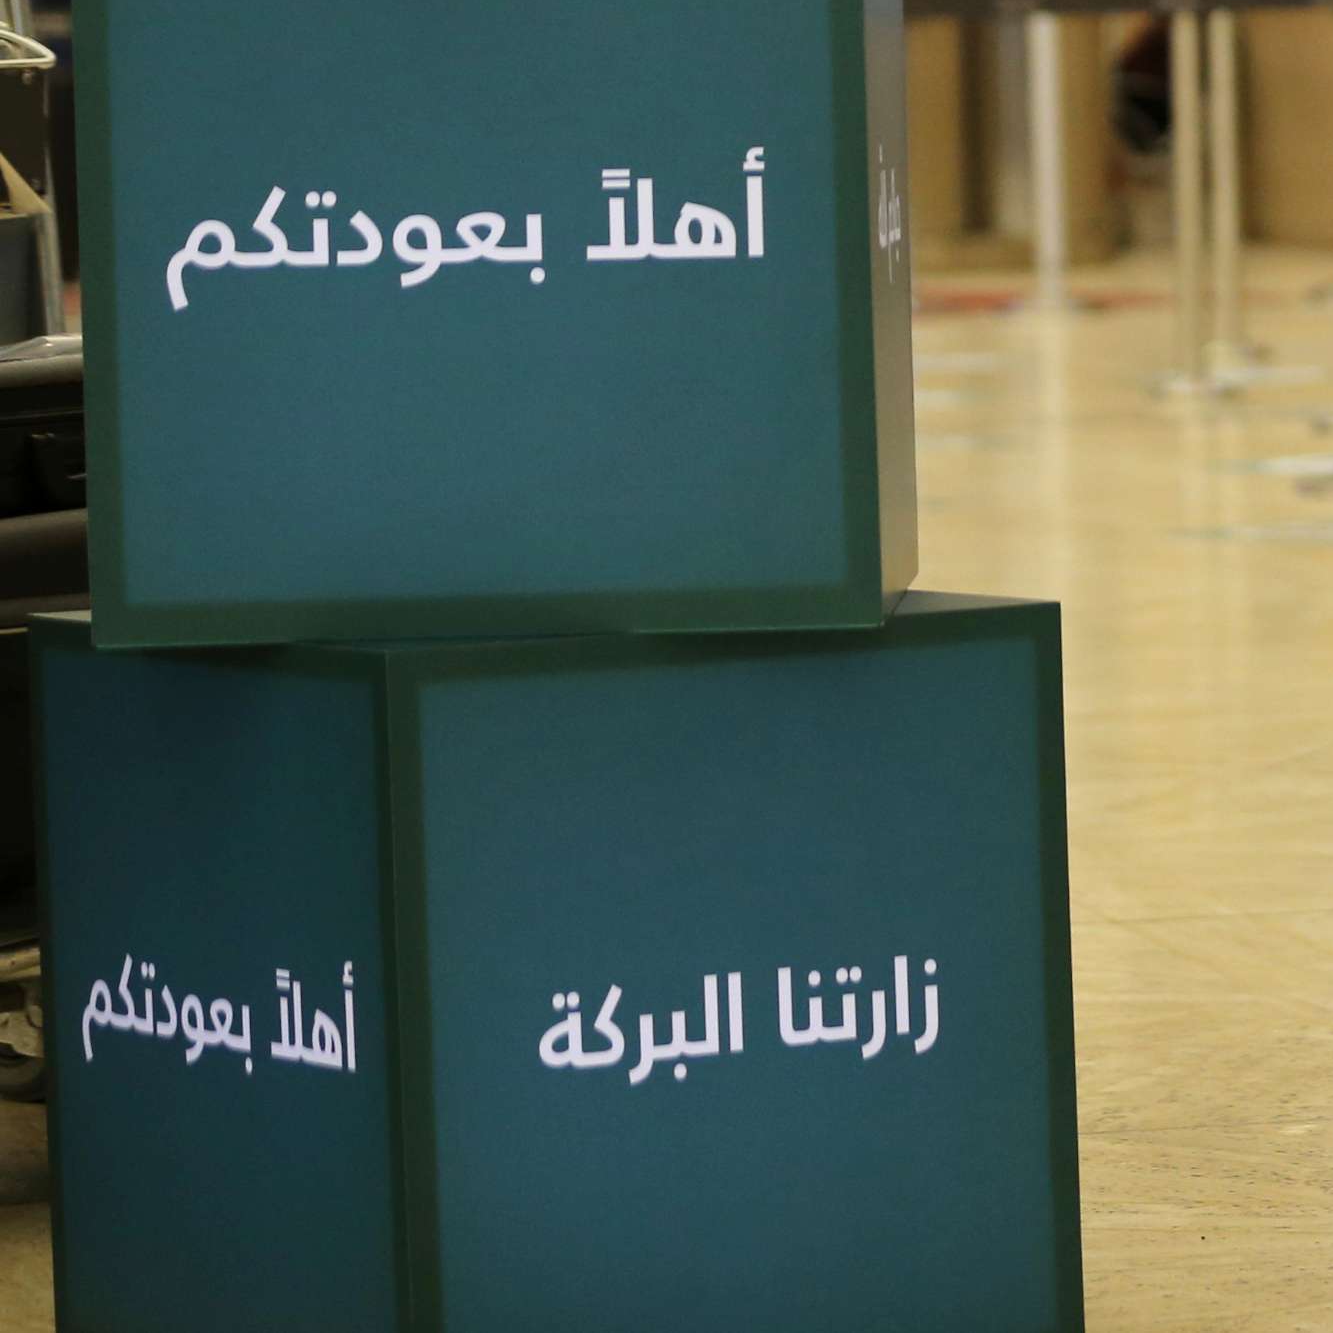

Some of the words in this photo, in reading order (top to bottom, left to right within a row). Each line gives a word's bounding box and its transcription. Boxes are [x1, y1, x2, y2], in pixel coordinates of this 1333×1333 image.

[166, 185, 546, 312] بعودتكم
[586, 146, 766, 261] أهلاً
[82, 952, 253, 1075] بعودتكم
[270, 960, 357, 1074] أهلاً
[538, 970, 744, 1086] البركة
[777, 955, 940, 1061] زارتنا
